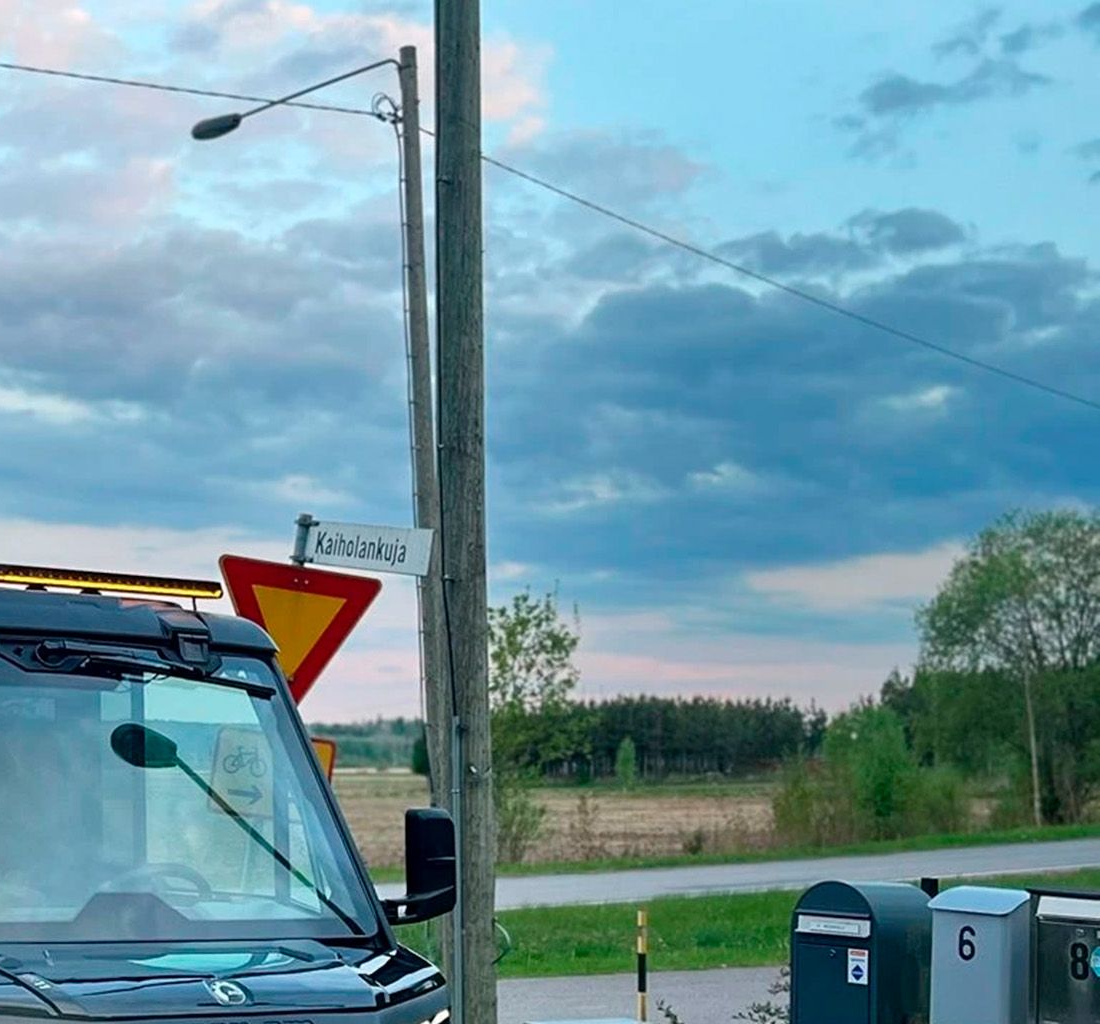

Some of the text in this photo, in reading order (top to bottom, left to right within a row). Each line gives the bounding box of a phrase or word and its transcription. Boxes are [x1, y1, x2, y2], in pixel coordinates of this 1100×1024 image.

[314, 531, 407, 566] Kaiholankuja
[958, 925, 976, 961] 6
[1071, 942, 1089, 981] 8
